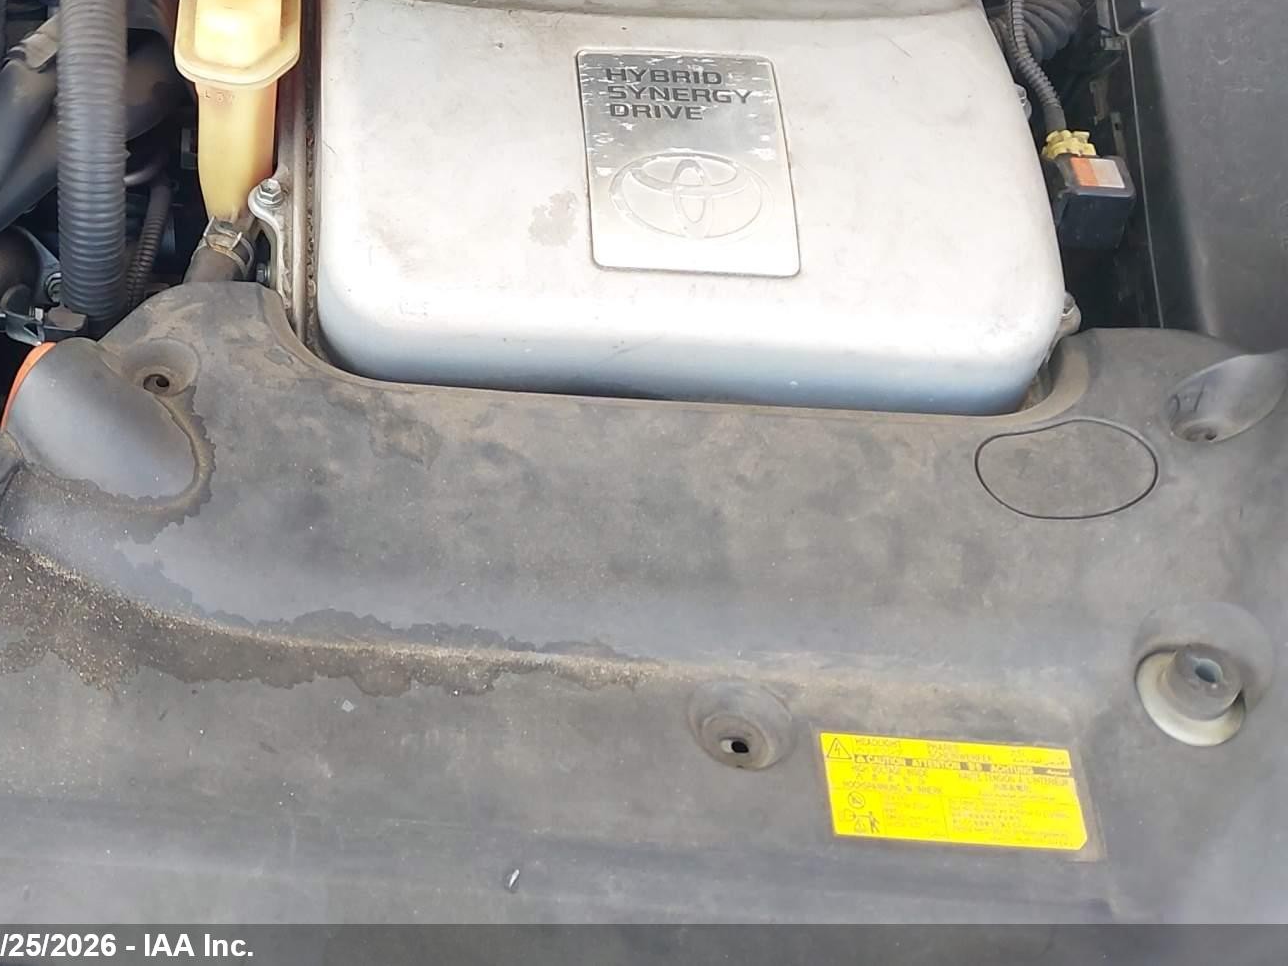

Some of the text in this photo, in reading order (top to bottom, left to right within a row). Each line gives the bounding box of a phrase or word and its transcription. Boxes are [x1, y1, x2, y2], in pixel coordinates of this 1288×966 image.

[606, 68, 722, 85] HYBRID
[607, 85, 752, 104] SYNERGY
[610, 104, 703, 120] DRIVE
